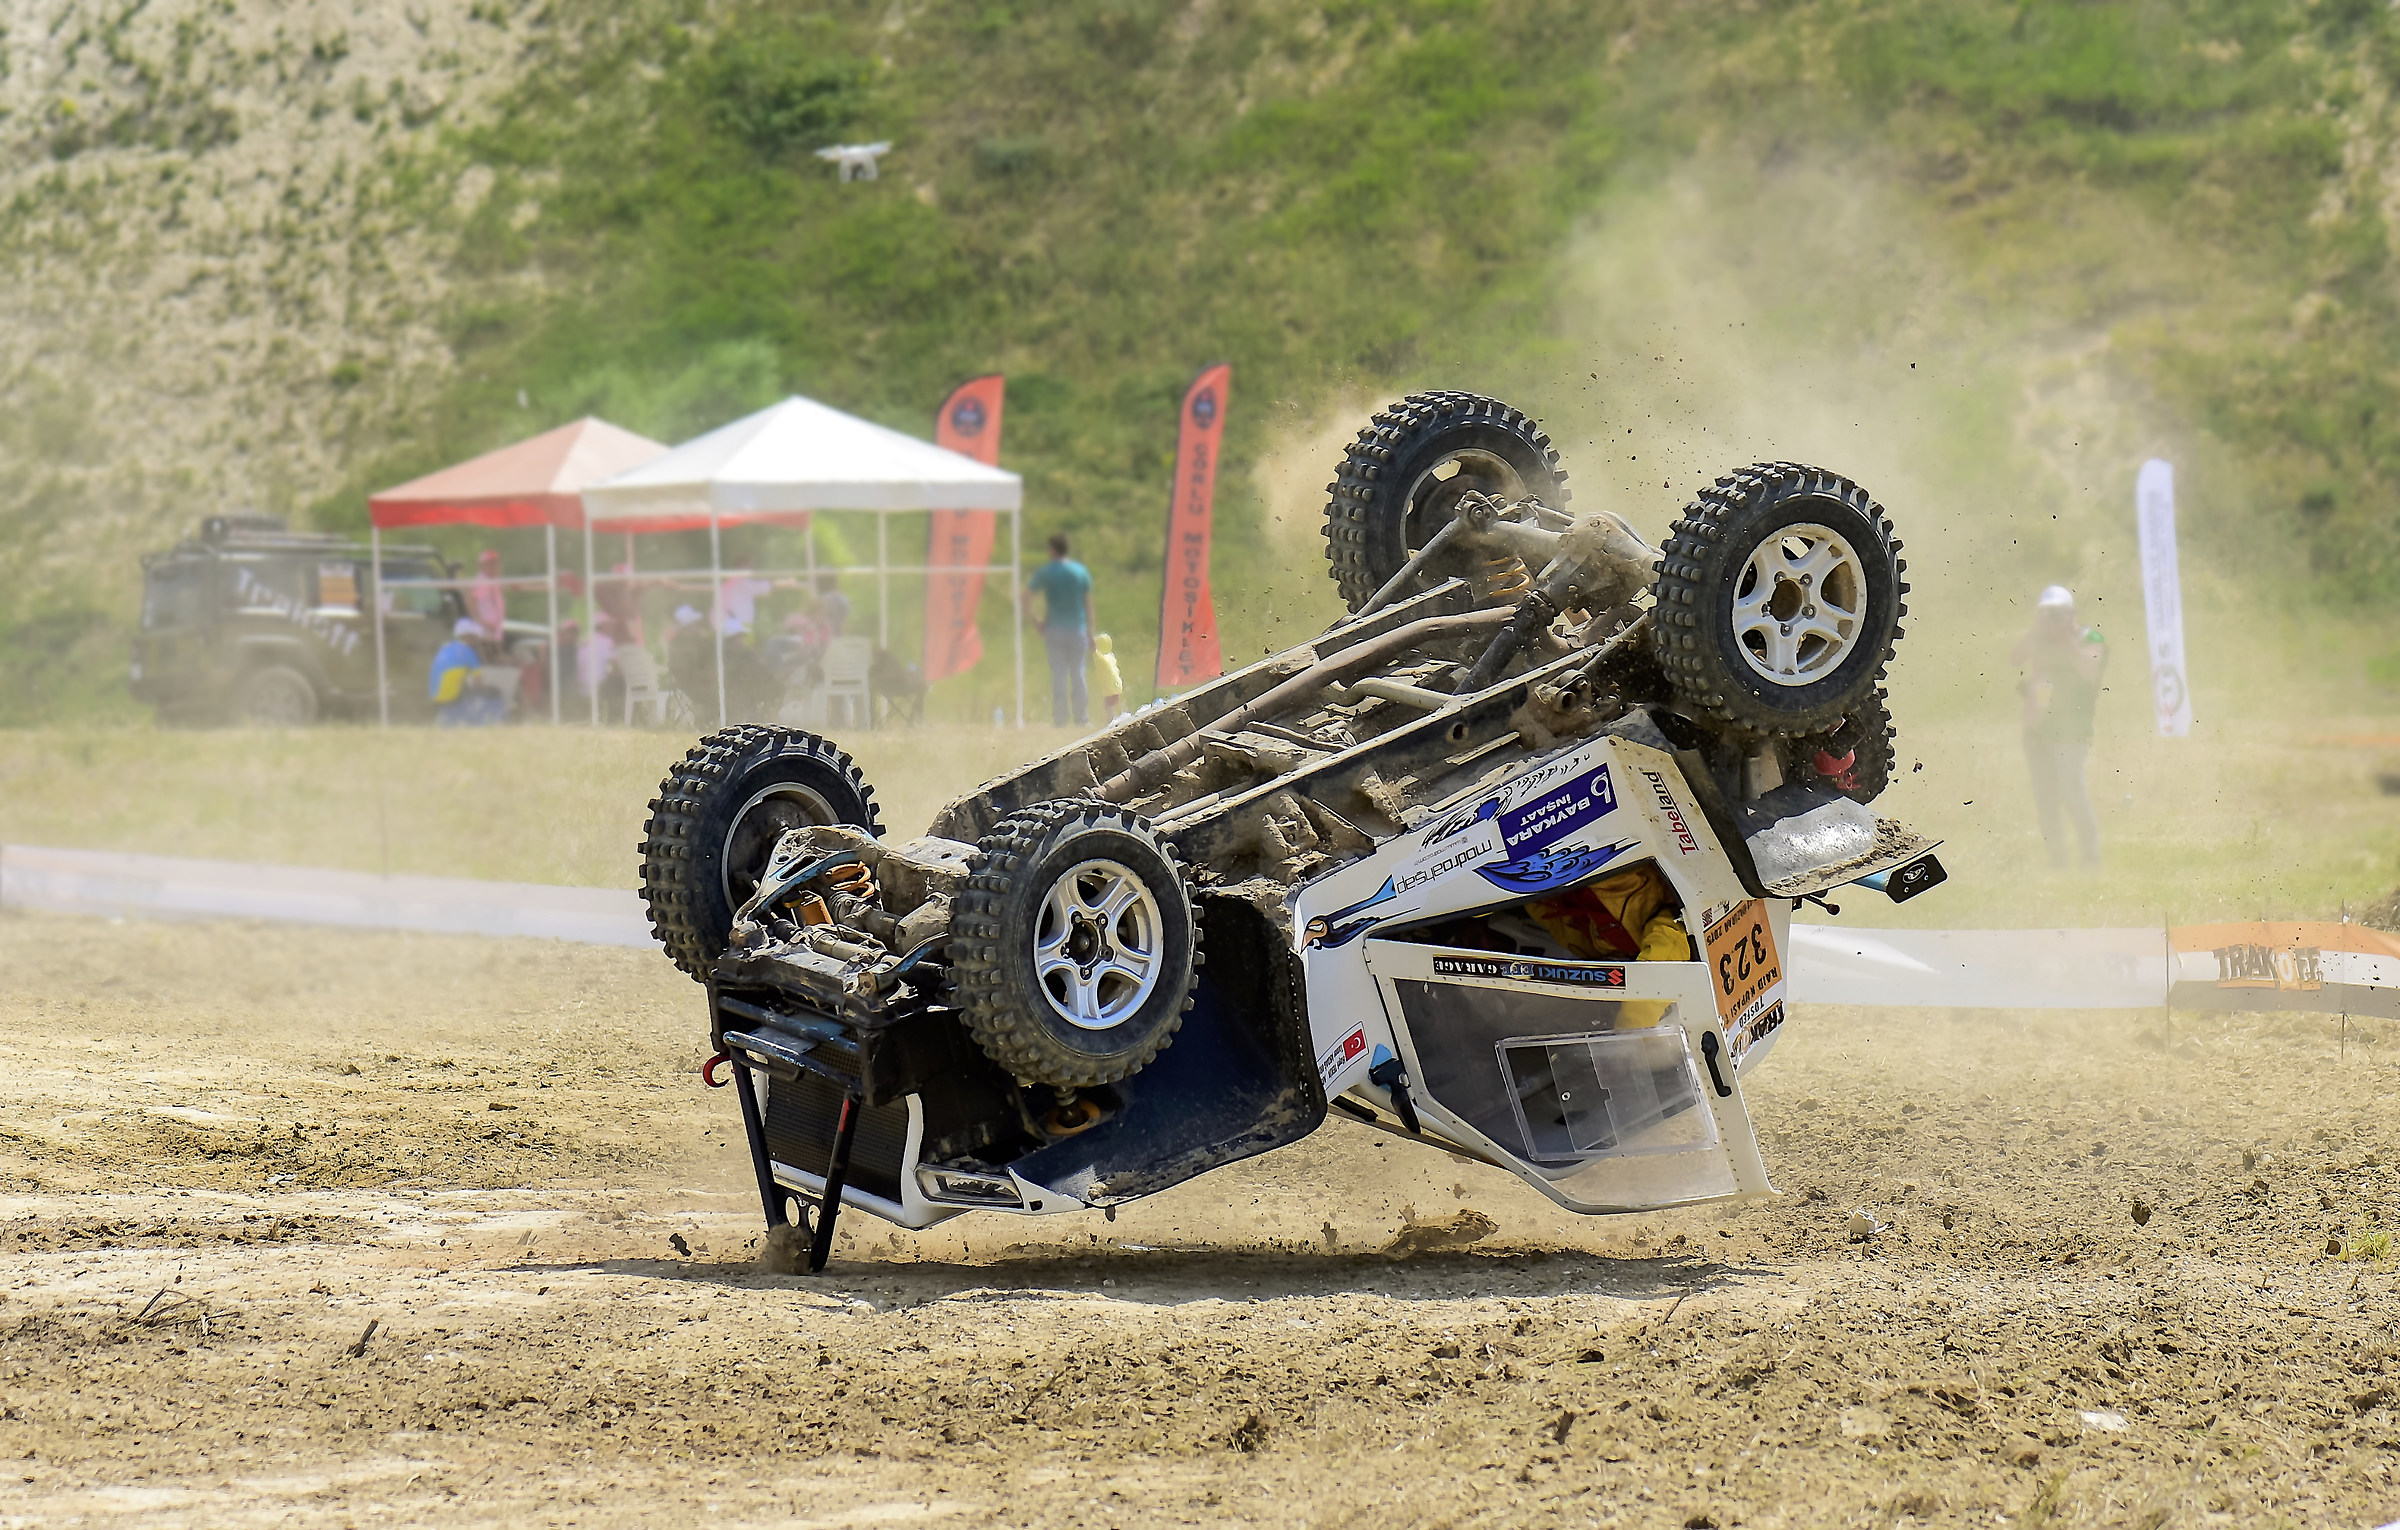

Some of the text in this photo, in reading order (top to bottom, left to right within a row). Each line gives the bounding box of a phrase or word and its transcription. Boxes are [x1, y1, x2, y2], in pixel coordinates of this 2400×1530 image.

[1506, 796, 1591, 847] BAYKARA
[1641, 771, 1697, 856] Tabeland
[1706, 925, 1723, 947] 2015
[1435, 960, 1498, 975] GARAGE
[1538, 966, 1607, 983] SUZUKI
[1719, 923, 1767, 996] 323
[2212, 944, 2324, 986] TRAKOFF
[1757, 966, 1779, 990] RAID
[1739, 995, 1765, 1028] TOSFED
